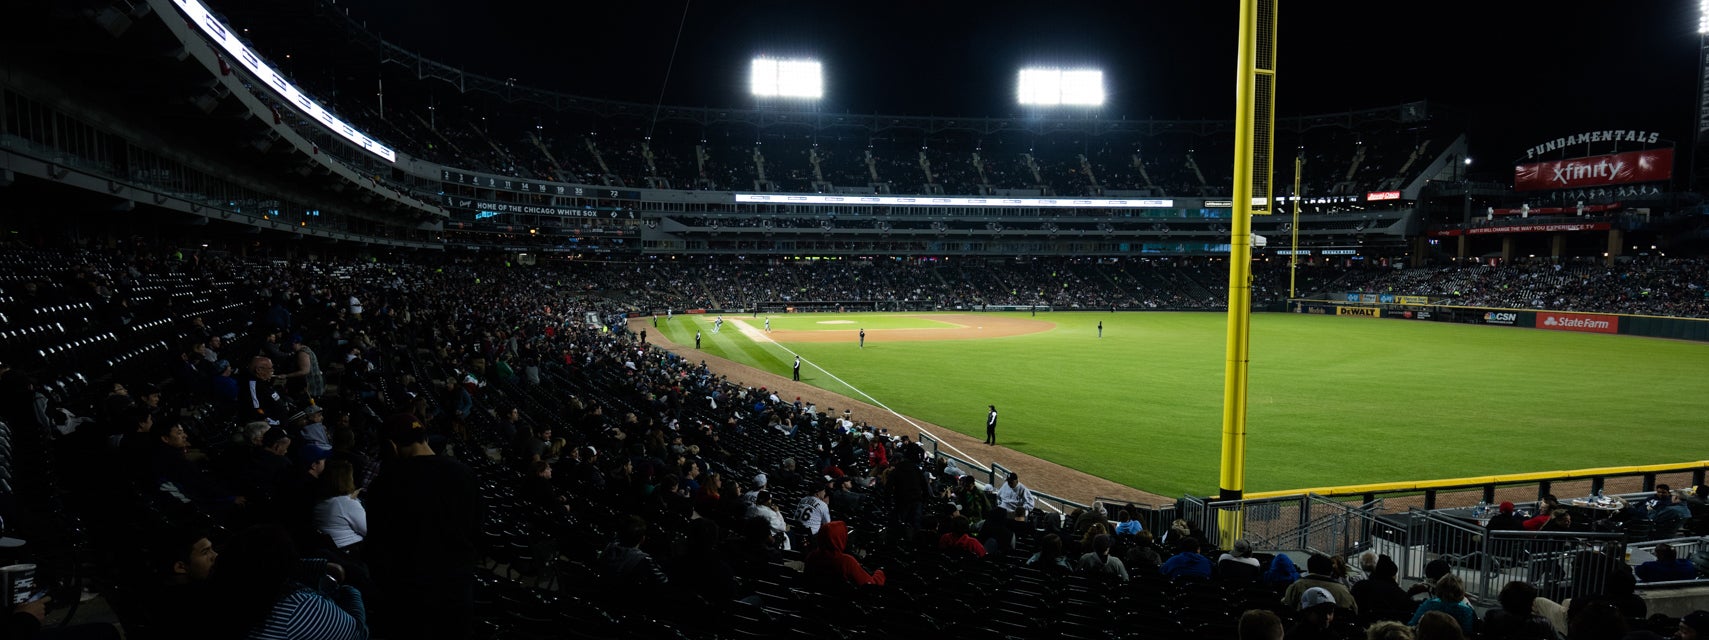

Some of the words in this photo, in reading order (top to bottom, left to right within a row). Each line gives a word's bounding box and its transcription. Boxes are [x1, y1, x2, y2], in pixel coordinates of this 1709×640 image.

[1526, 129, 1660, 159] FUNDAMENTALS
[1552, 159, 1624, 185] xfinity
[477, 202, 497, 210] HOME
[523, 206, 555, 214] CHICAGO
[557, 208, 581, 216] WHITE
[1496, 312, 1516, 322] CSN
